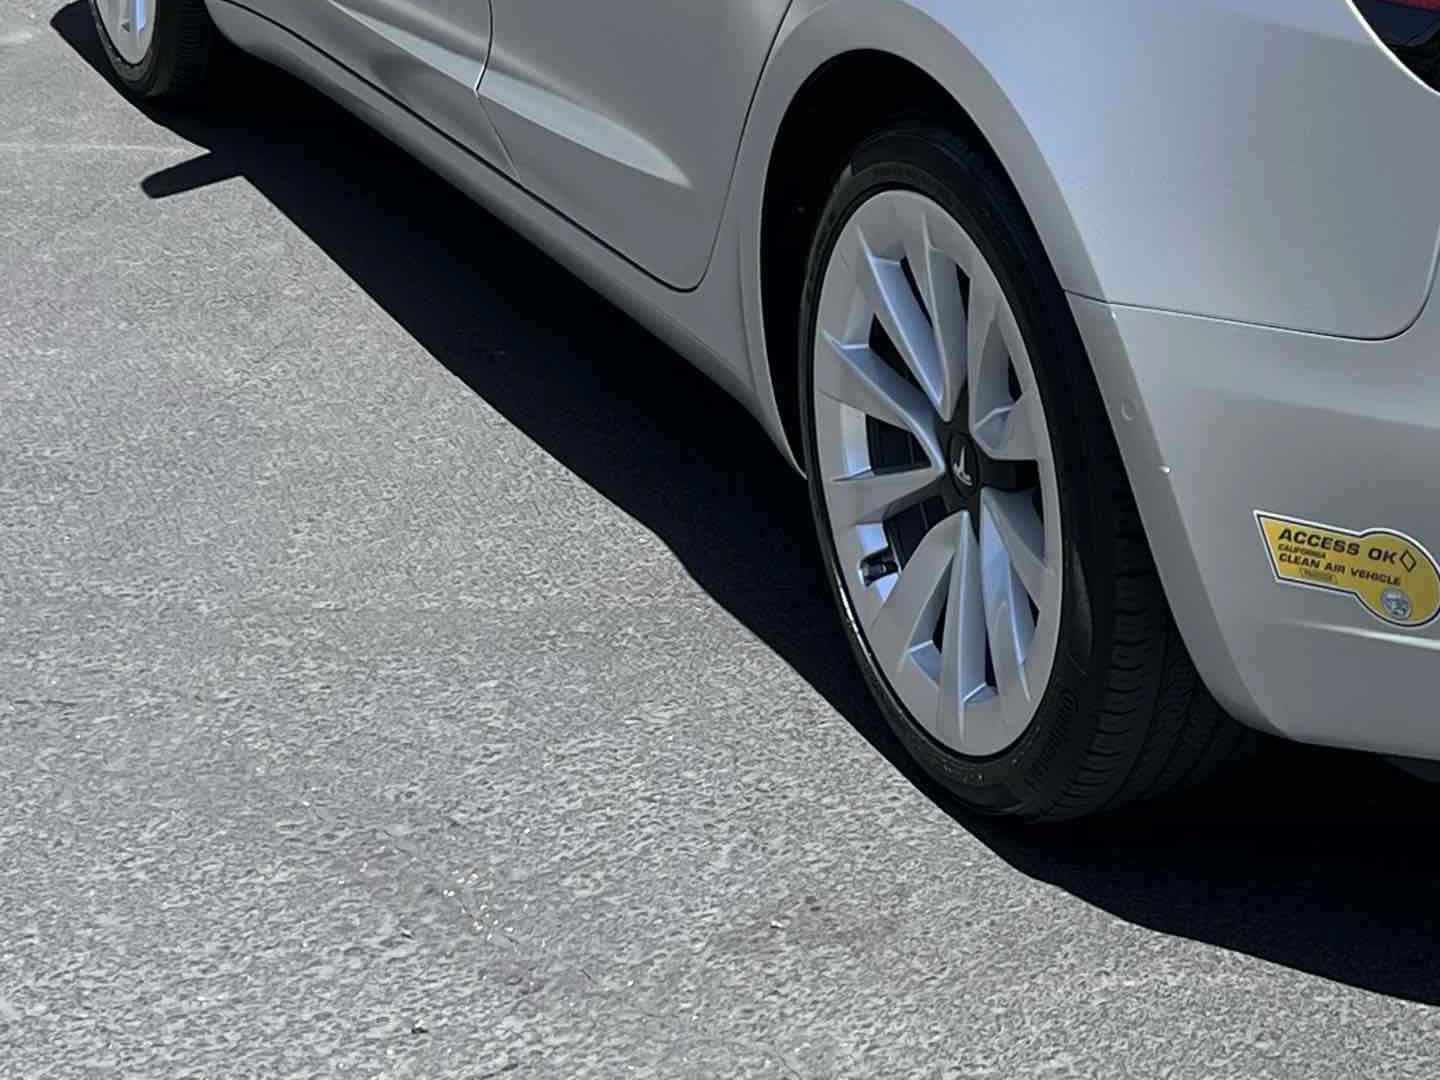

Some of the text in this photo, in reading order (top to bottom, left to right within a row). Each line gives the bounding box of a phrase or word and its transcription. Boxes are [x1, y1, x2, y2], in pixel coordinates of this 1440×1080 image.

[1278, 528, 1399, 565] ACCESS OK
[1278, 544, 1326, 559] CALIFORNIA
[1279, 553, 1321, 569] CLEAN
[1324, 560, 1346, 573] AIR
[1350, 568, 1402, 585] VEHICLE
